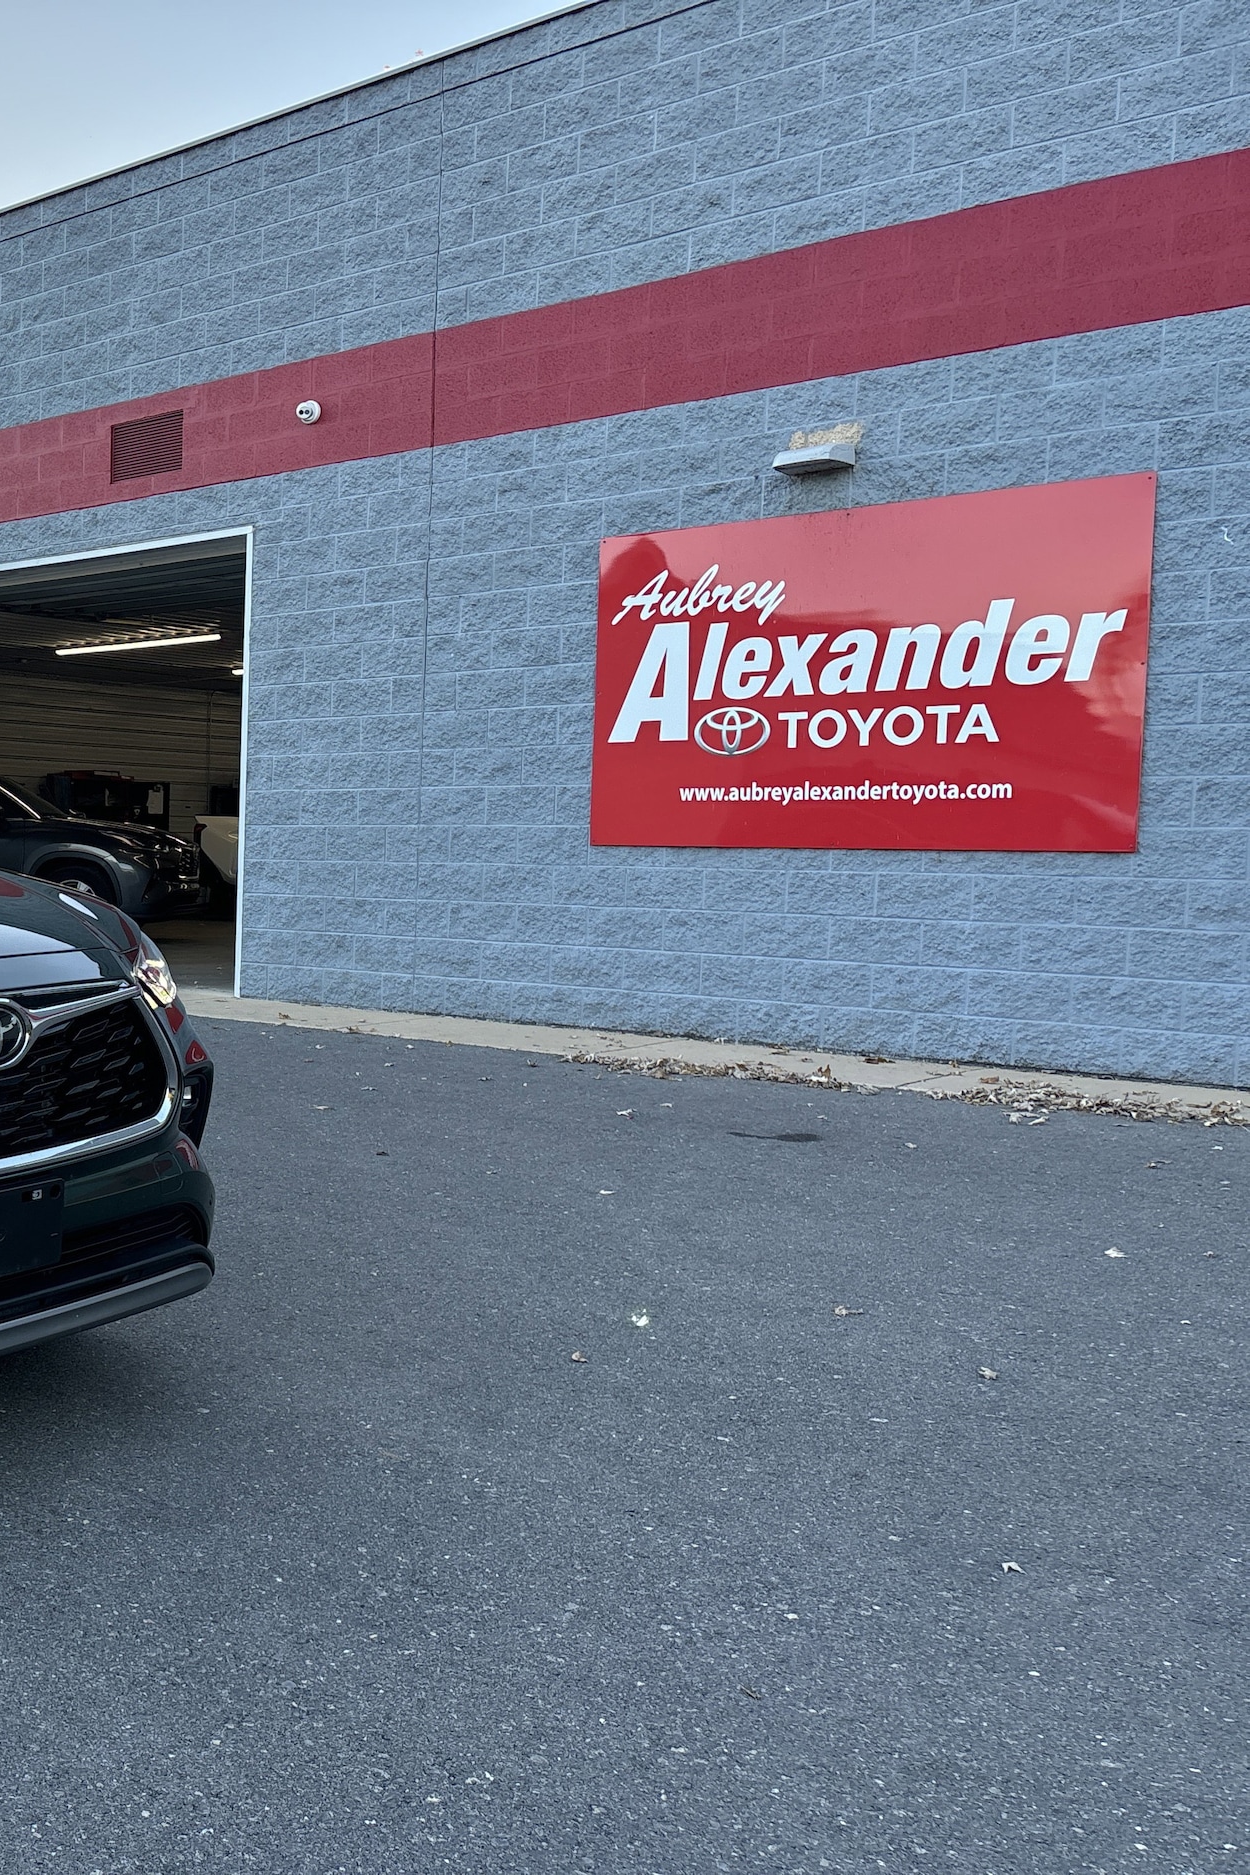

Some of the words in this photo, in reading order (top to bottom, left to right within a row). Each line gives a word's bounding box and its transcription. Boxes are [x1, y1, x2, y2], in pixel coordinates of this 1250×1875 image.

[611, 563, 786, 626] Aubrey
[607, 598, 1129, 744] Alexander
[778, 704, 1000, 749] TOYOTA
[679, 779, 1013, 806] www.aubreyalexandertoyota.com
